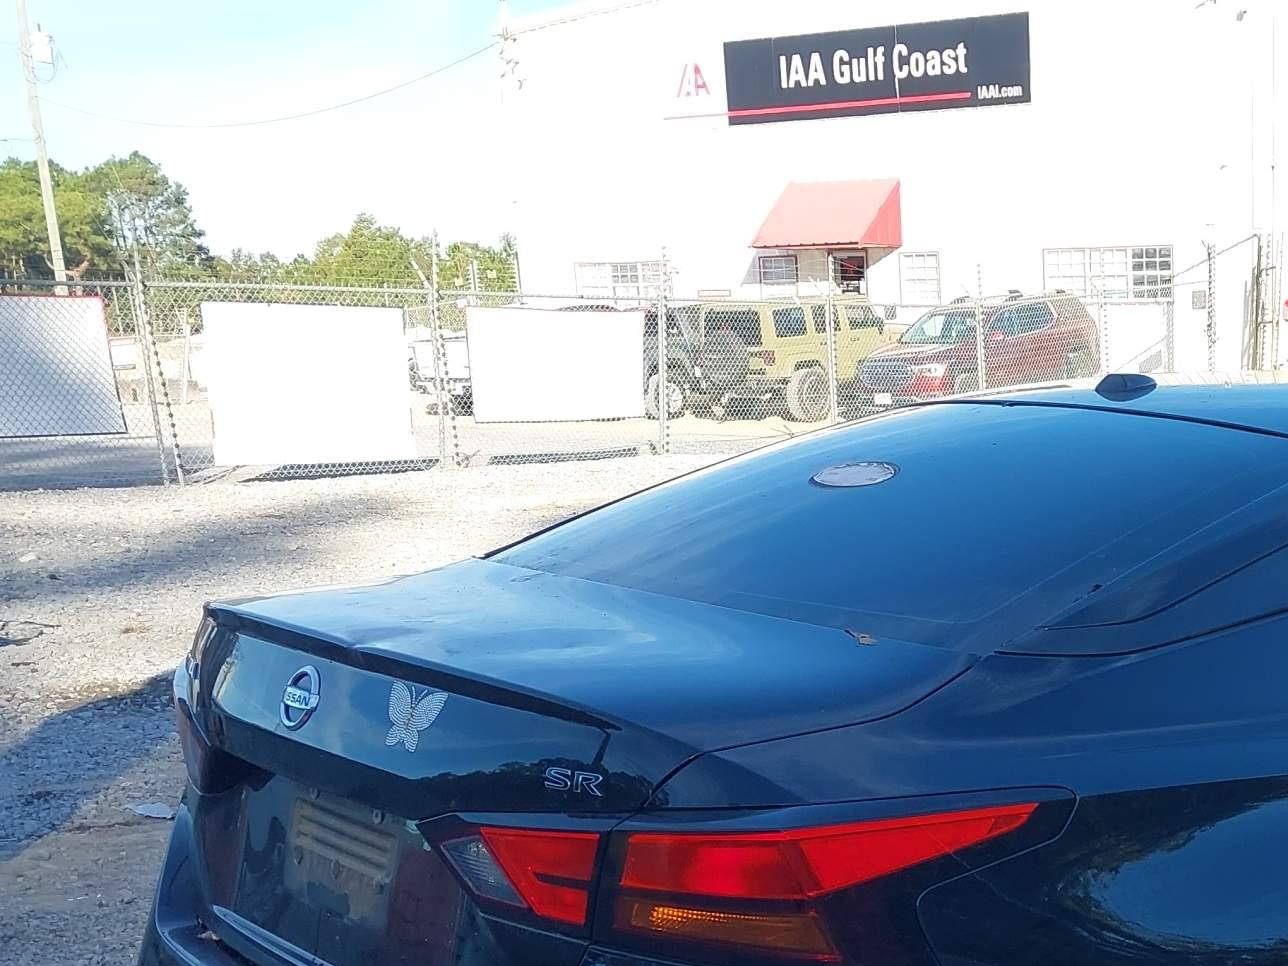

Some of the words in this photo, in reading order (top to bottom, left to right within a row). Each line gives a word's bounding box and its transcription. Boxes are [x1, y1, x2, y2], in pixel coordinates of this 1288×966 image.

[779, 52, 827, 89] IAA
[832, 46, 885, 84] Gulf
[892, 42, 968, 79] Coast
[544, 767, 603, 797] SR
